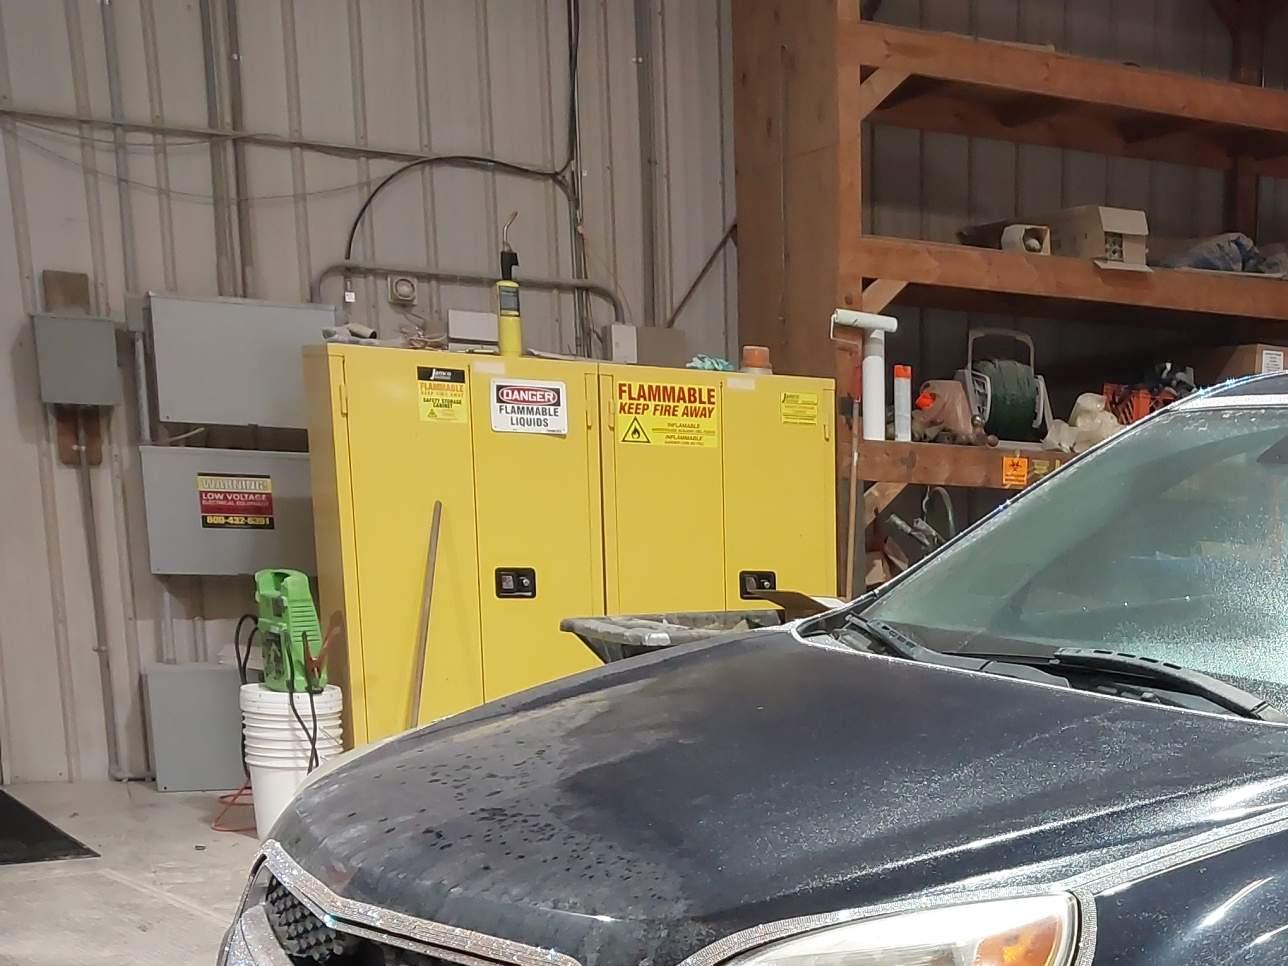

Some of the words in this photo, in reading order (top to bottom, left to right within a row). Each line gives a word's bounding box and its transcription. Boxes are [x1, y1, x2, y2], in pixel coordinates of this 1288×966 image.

[503, 389, 554, 402] DANGER
[618, 383, 716, 405] FLAMMABLE
[499, 405, 559, 417] FLAMMABLE
[619, 402, 649, 415] KEEP
[653, 404, 680, 417] FIRE
[681, 405, 715, 418] AWAY
[510, 416, 549, 427] LIQUIDS
[202, 492, 224, 500] LOW
[226, 493, 267, 501] VOLTAGE
